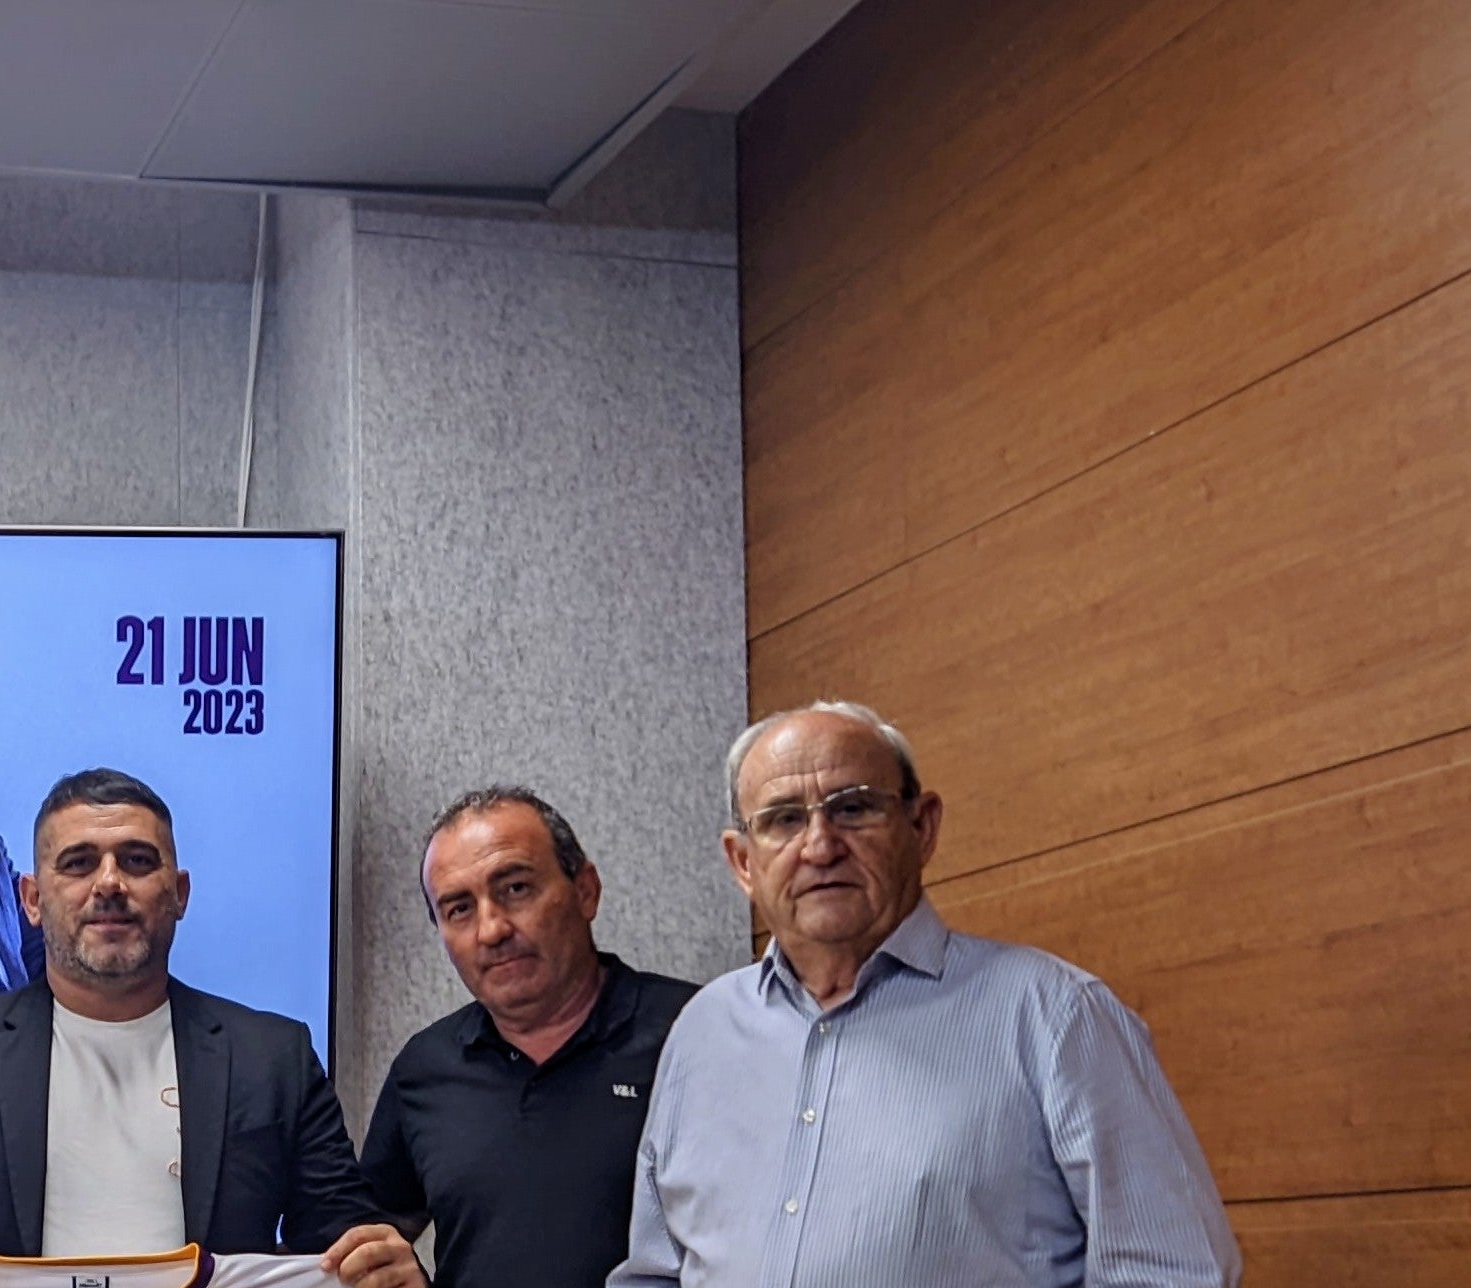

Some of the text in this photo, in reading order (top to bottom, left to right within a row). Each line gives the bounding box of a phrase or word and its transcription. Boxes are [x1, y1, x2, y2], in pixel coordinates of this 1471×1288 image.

[116, 614, 264, 686] 21 JUN
[183, 688, 264, 735] 2023
